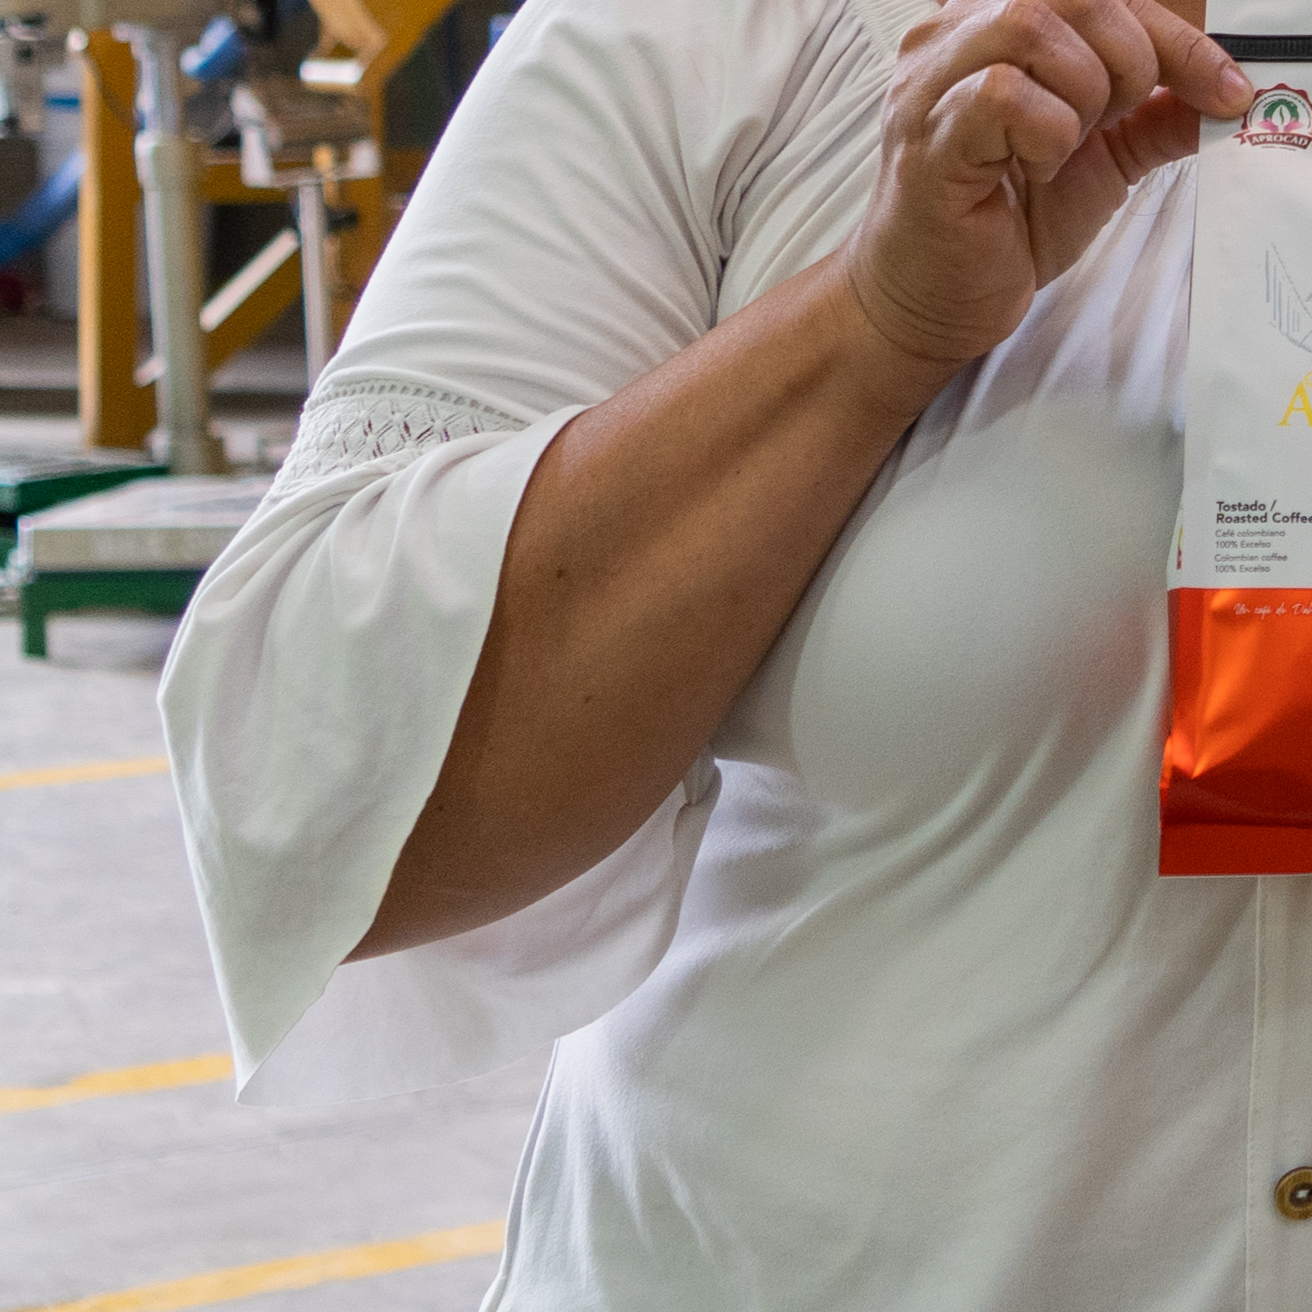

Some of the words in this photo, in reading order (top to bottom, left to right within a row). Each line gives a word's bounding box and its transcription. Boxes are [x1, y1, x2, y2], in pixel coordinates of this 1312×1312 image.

[1251, 134, 1309, 146] APROCAD
[1216, 500, 1267, 512] Tostado
[1270, 499, 1277, 512] /
[1216, 512, 1268, 524] Roasted
[1214, 529, 1235, 538] Café
[1236, 529, 1286, 538] colombiano
[1216, 540, 1238, 549] 100%
[1240, 540, 1271, 549] Excelso
[1214, 553, 1259, 563] Colombian
[1260, 552, 1288, 562] coffee
[1214, 564, 1237, 574] 100%
[1239, 564, 1271, 573] Excelso
